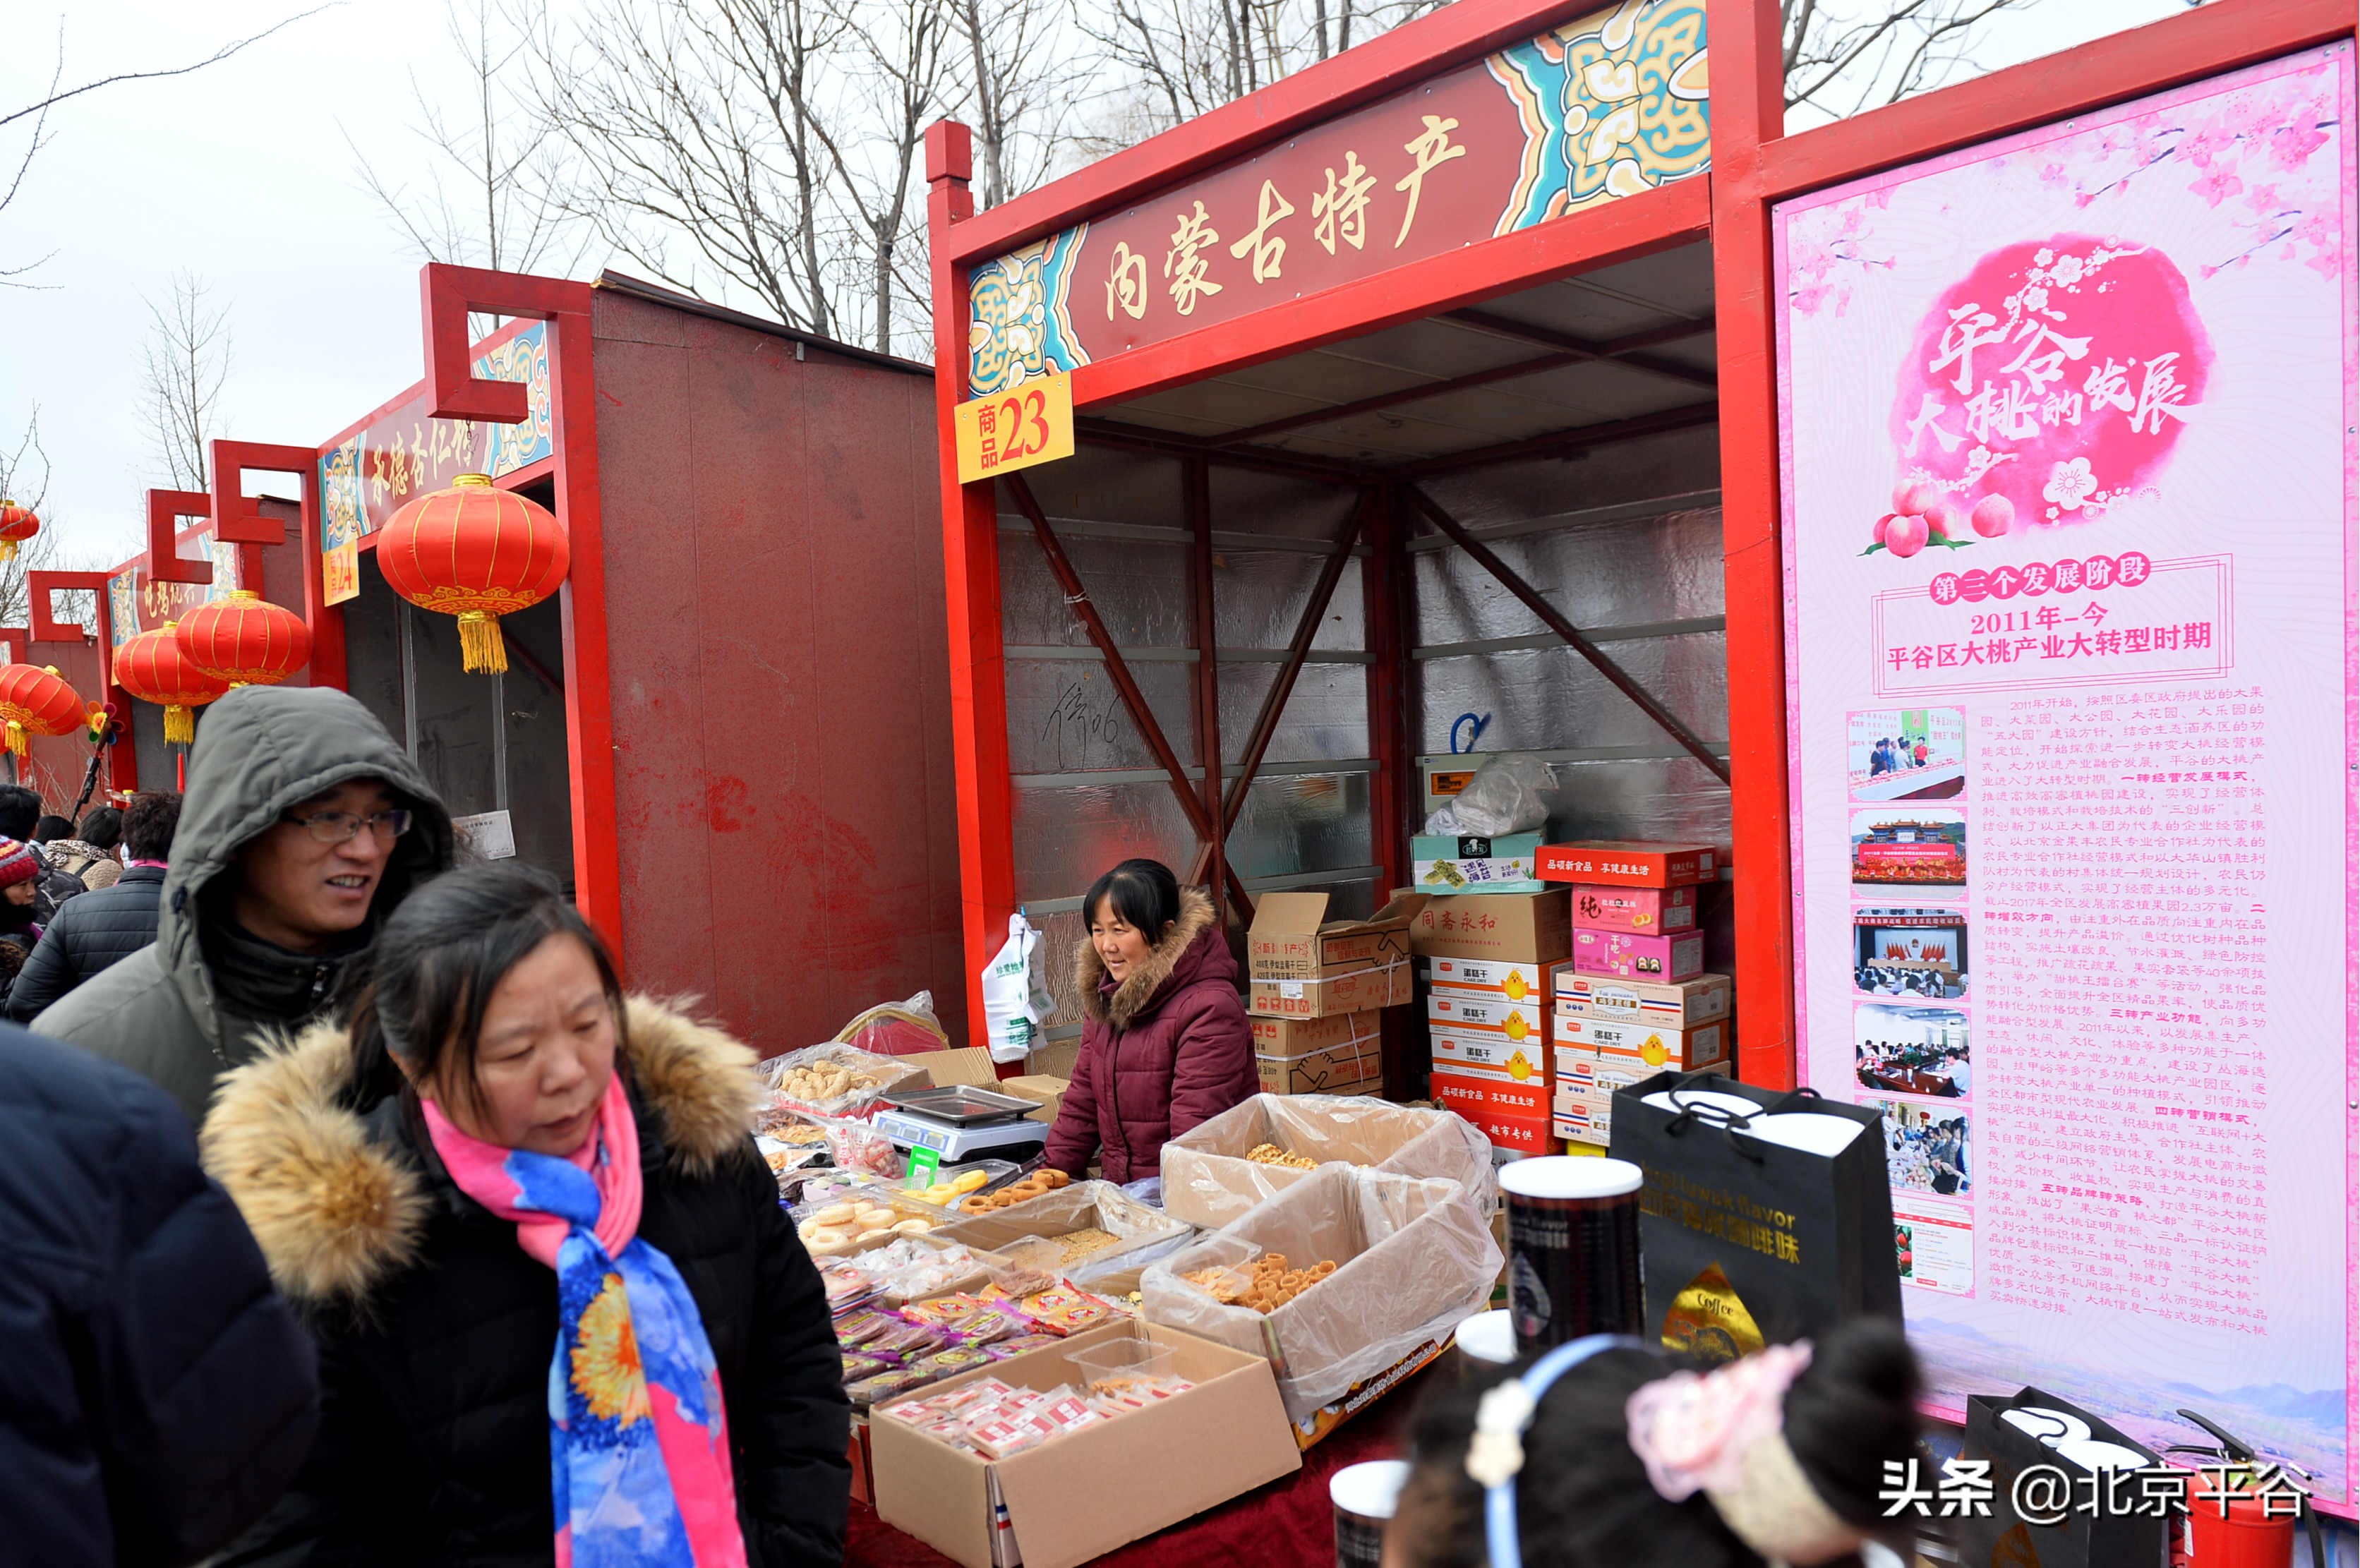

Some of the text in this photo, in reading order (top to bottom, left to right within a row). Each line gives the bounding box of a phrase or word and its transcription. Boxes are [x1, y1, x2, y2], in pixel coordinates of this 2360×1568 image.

[1104, 115, 1467, 321] 内蒙古特产
[1929, 303, 2094, 395] 平谷
[1904, 351, 2205, 459] 大桃的发展
[977, 390, 1049, 470] 商品 23
[337, 549, 352, 594] 24
[1933, 555, 2148, 602] 第三个发展阶段
[1970, 601, 2109, 635] 2011年-今
[1886, 622, 2212, 673] 平谷区大桃产业大转型时期
[1600, 862, 1650, 876] 享健康生活
[1579, 895, 1602, 919] 纯
[1422, 910, 1497, 933] 同斋永和
[1463, 967, 1488, 979] 蛋糕干
[1462, 1008, 1488, 1018] 蛋糕干
[1594, 1030, 1622, 1042] 蛋糕干
[1466, 1047, 1491, 1058] 蛋糕干
[1491, 1092, 1536, 1107] 享健康生活
[1489, 1124, 1533, 1141] 超市专供
[1697, 1293, 1734, 1317] Coffee
